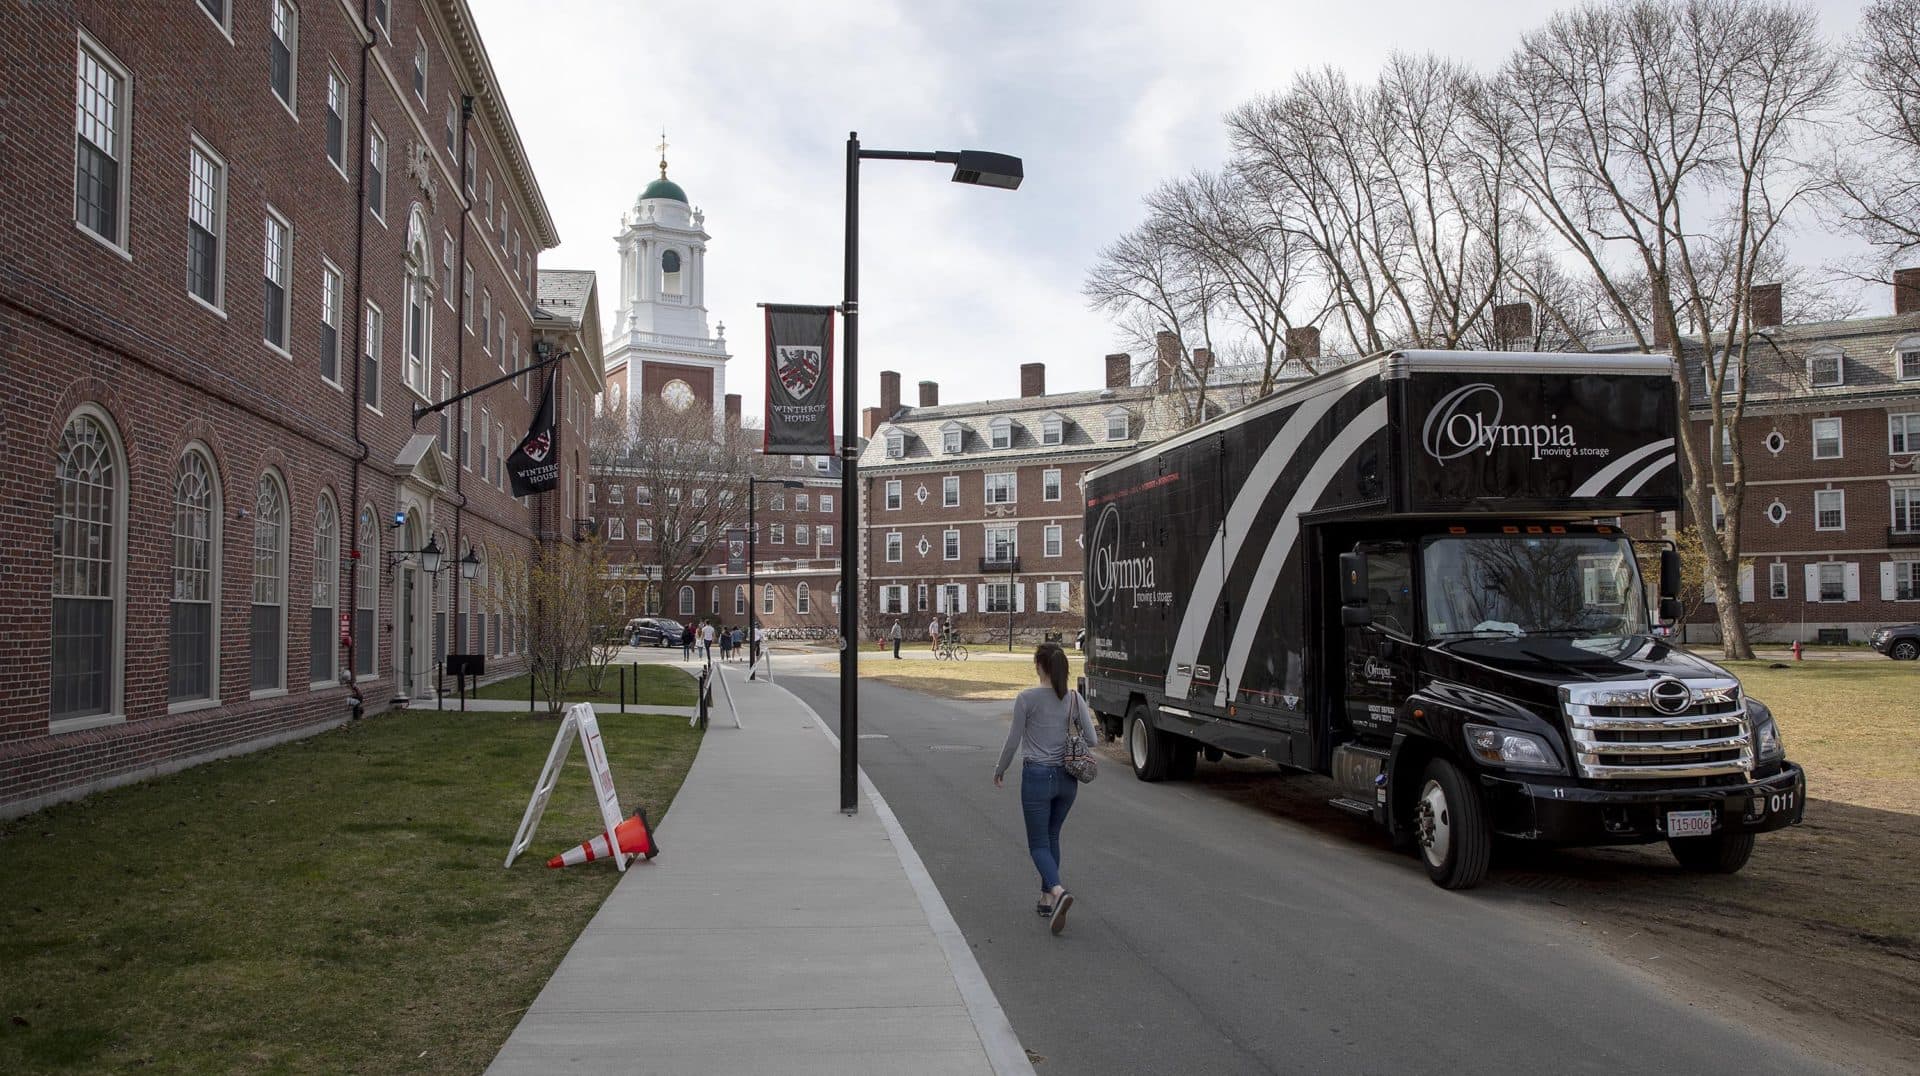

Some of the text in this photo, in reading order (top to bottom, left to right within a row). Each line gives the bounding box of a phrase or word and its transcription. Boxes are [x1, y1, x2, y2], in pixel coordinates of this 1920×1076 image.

[773, 404, 826, 413] WINTHROP
[784, 414, 817, 422] HOUSE
[1446, 412, 1576, 460] Olympia
[1541, 447, 1610, 458] moving & storage
[517, 463, 559, 478] WINTHRO
[530, 471, 559, 484] HOUSE
[1097, 541, 1155, 608] Olympia
[1137, 591, 1153, 606] moving
[1157, 591, 1173, 606] storage
[1553, 788, 1564, 798] 11
[1771, 791, 1793, 813] 011
